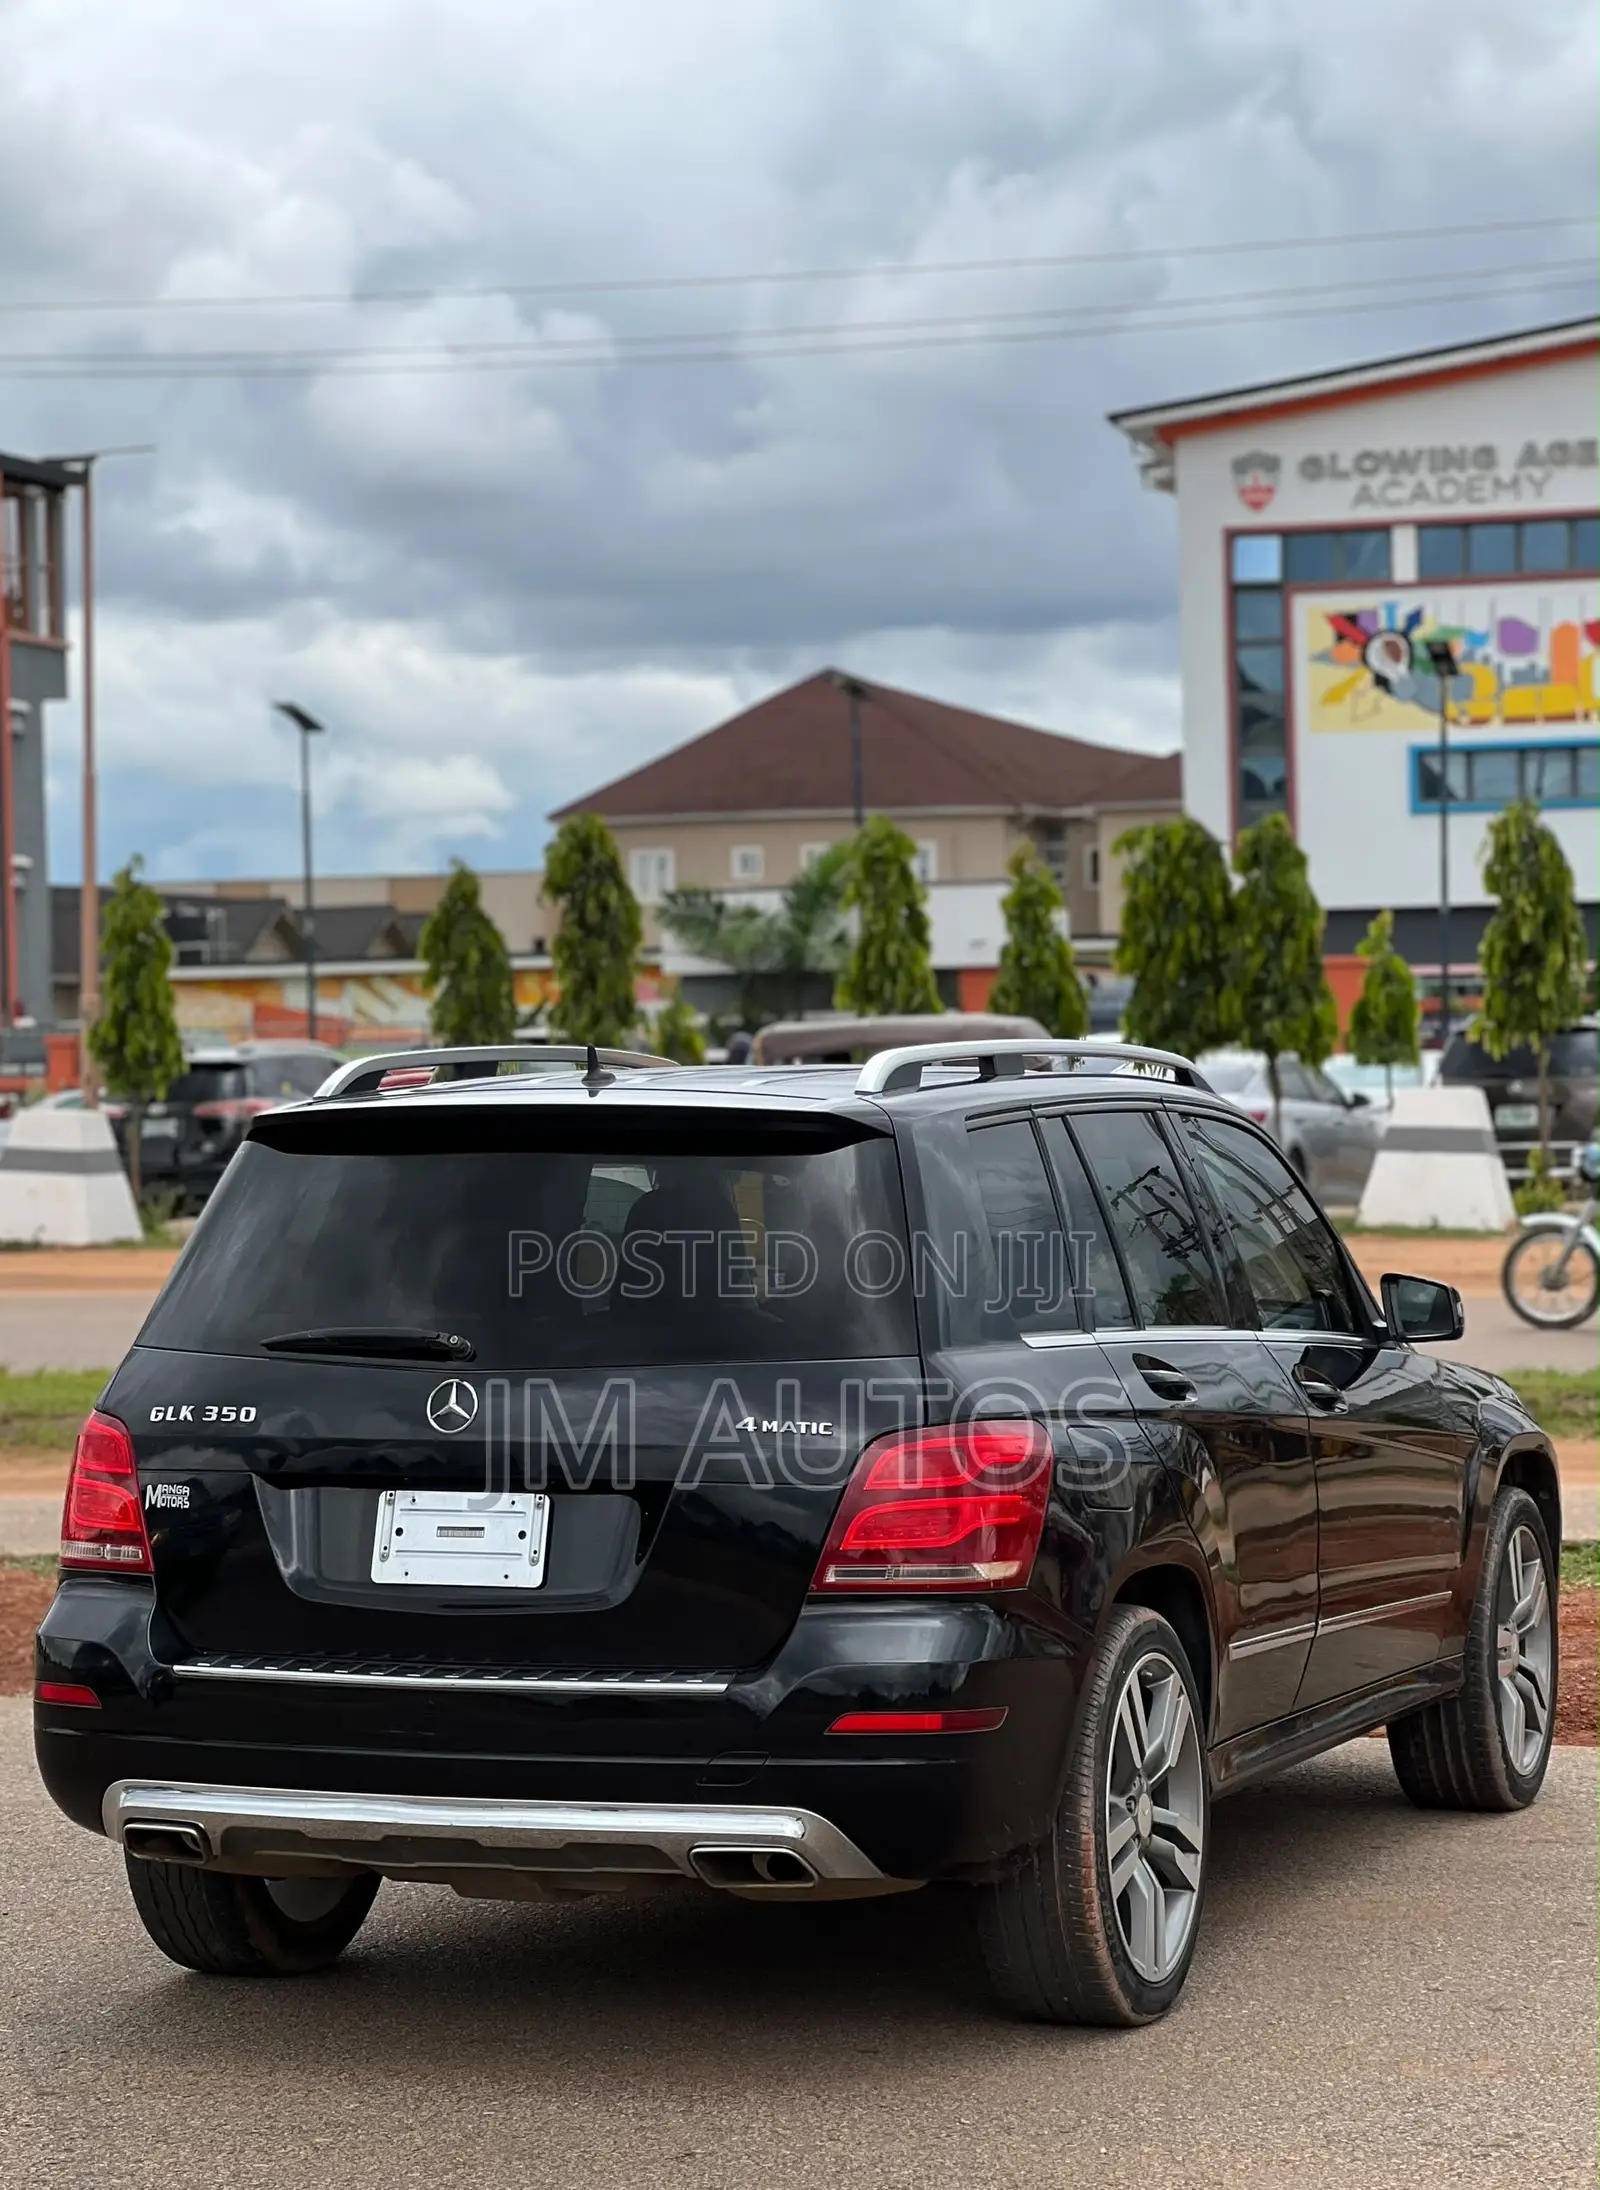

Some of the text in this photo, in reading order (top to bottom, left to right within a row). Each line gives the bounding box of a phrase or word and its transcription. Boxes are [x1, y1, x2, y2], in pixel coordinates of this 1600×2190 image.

[1297, 443, 1497, 482] GLOWING
[1351, 467, 1553, 508] ACADEMY
[149, 1405, 257, 1423] GLK 350
[145, 1484, 190, 1503] MANGA
[145, 1491, 190, 1510] MOTORS
